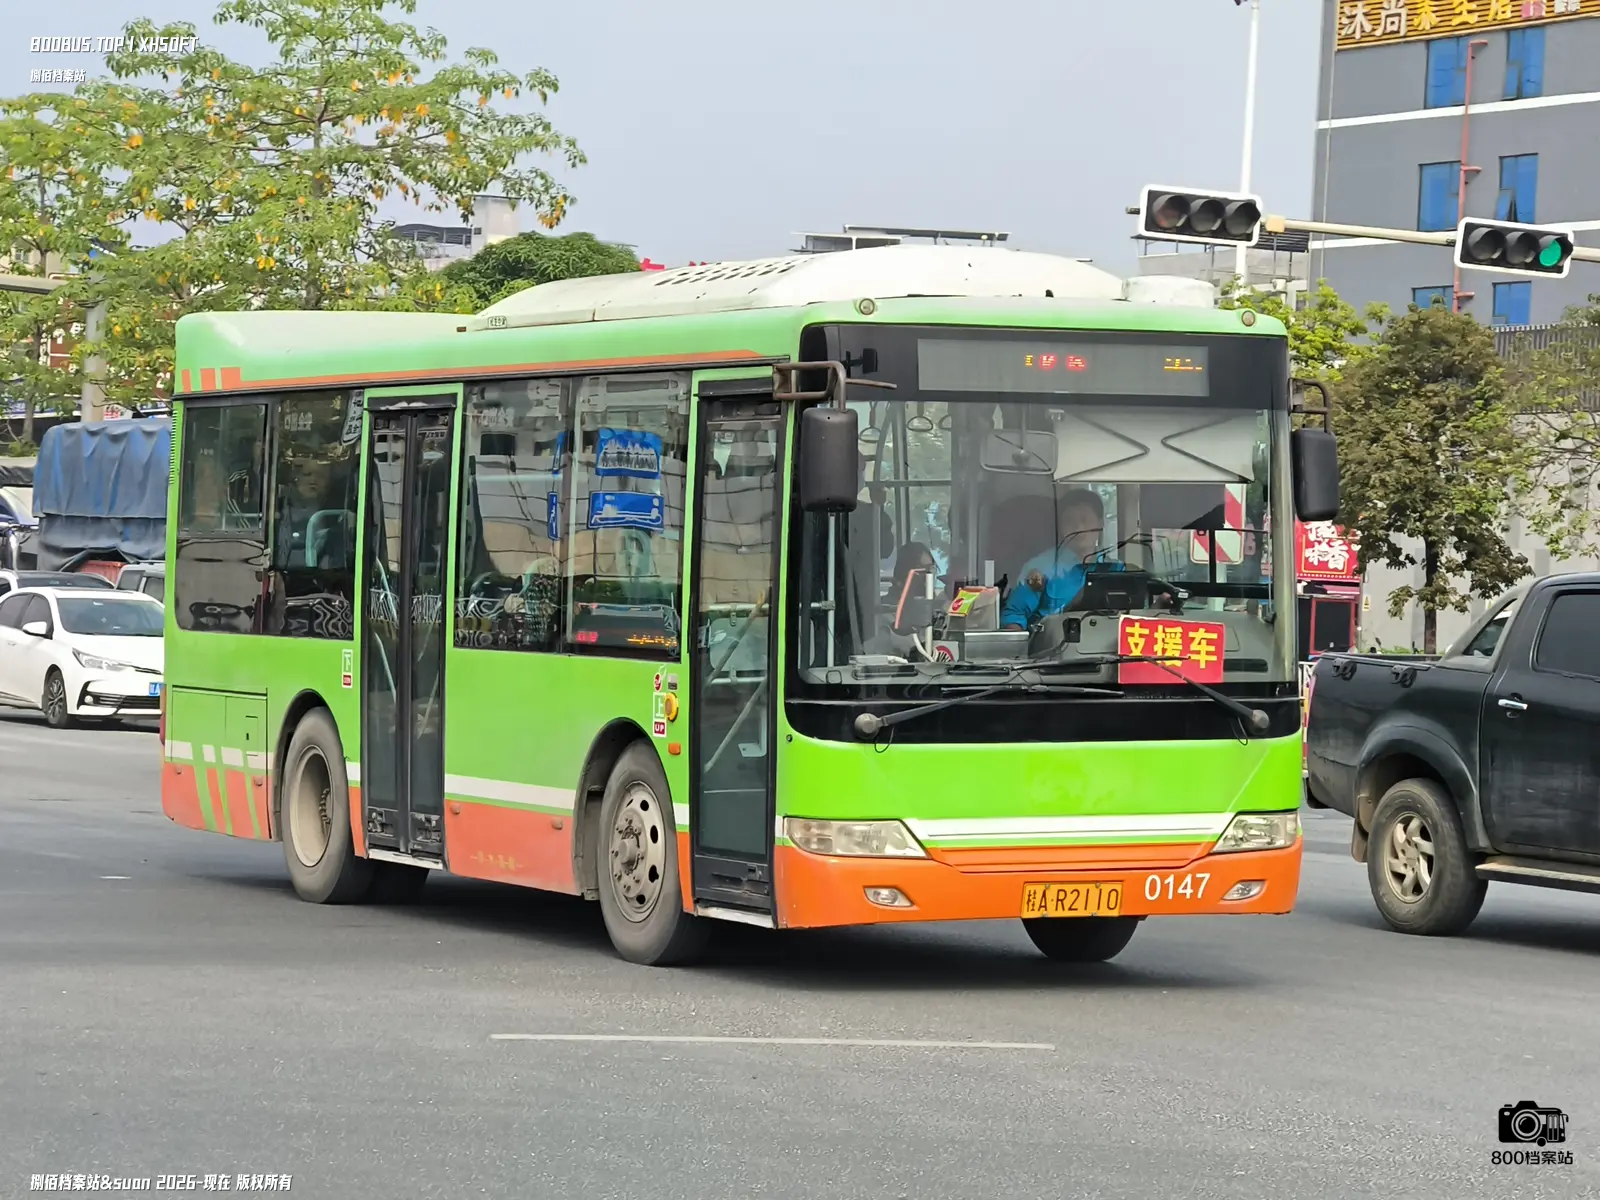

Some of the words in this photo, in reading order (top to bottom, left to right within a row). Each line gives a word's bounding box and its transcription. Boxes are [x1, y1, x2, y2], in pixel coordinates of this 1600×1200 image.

[1125, 622, 1218, 669] 支援车
[1144, 873, 1211, 900] 0147
